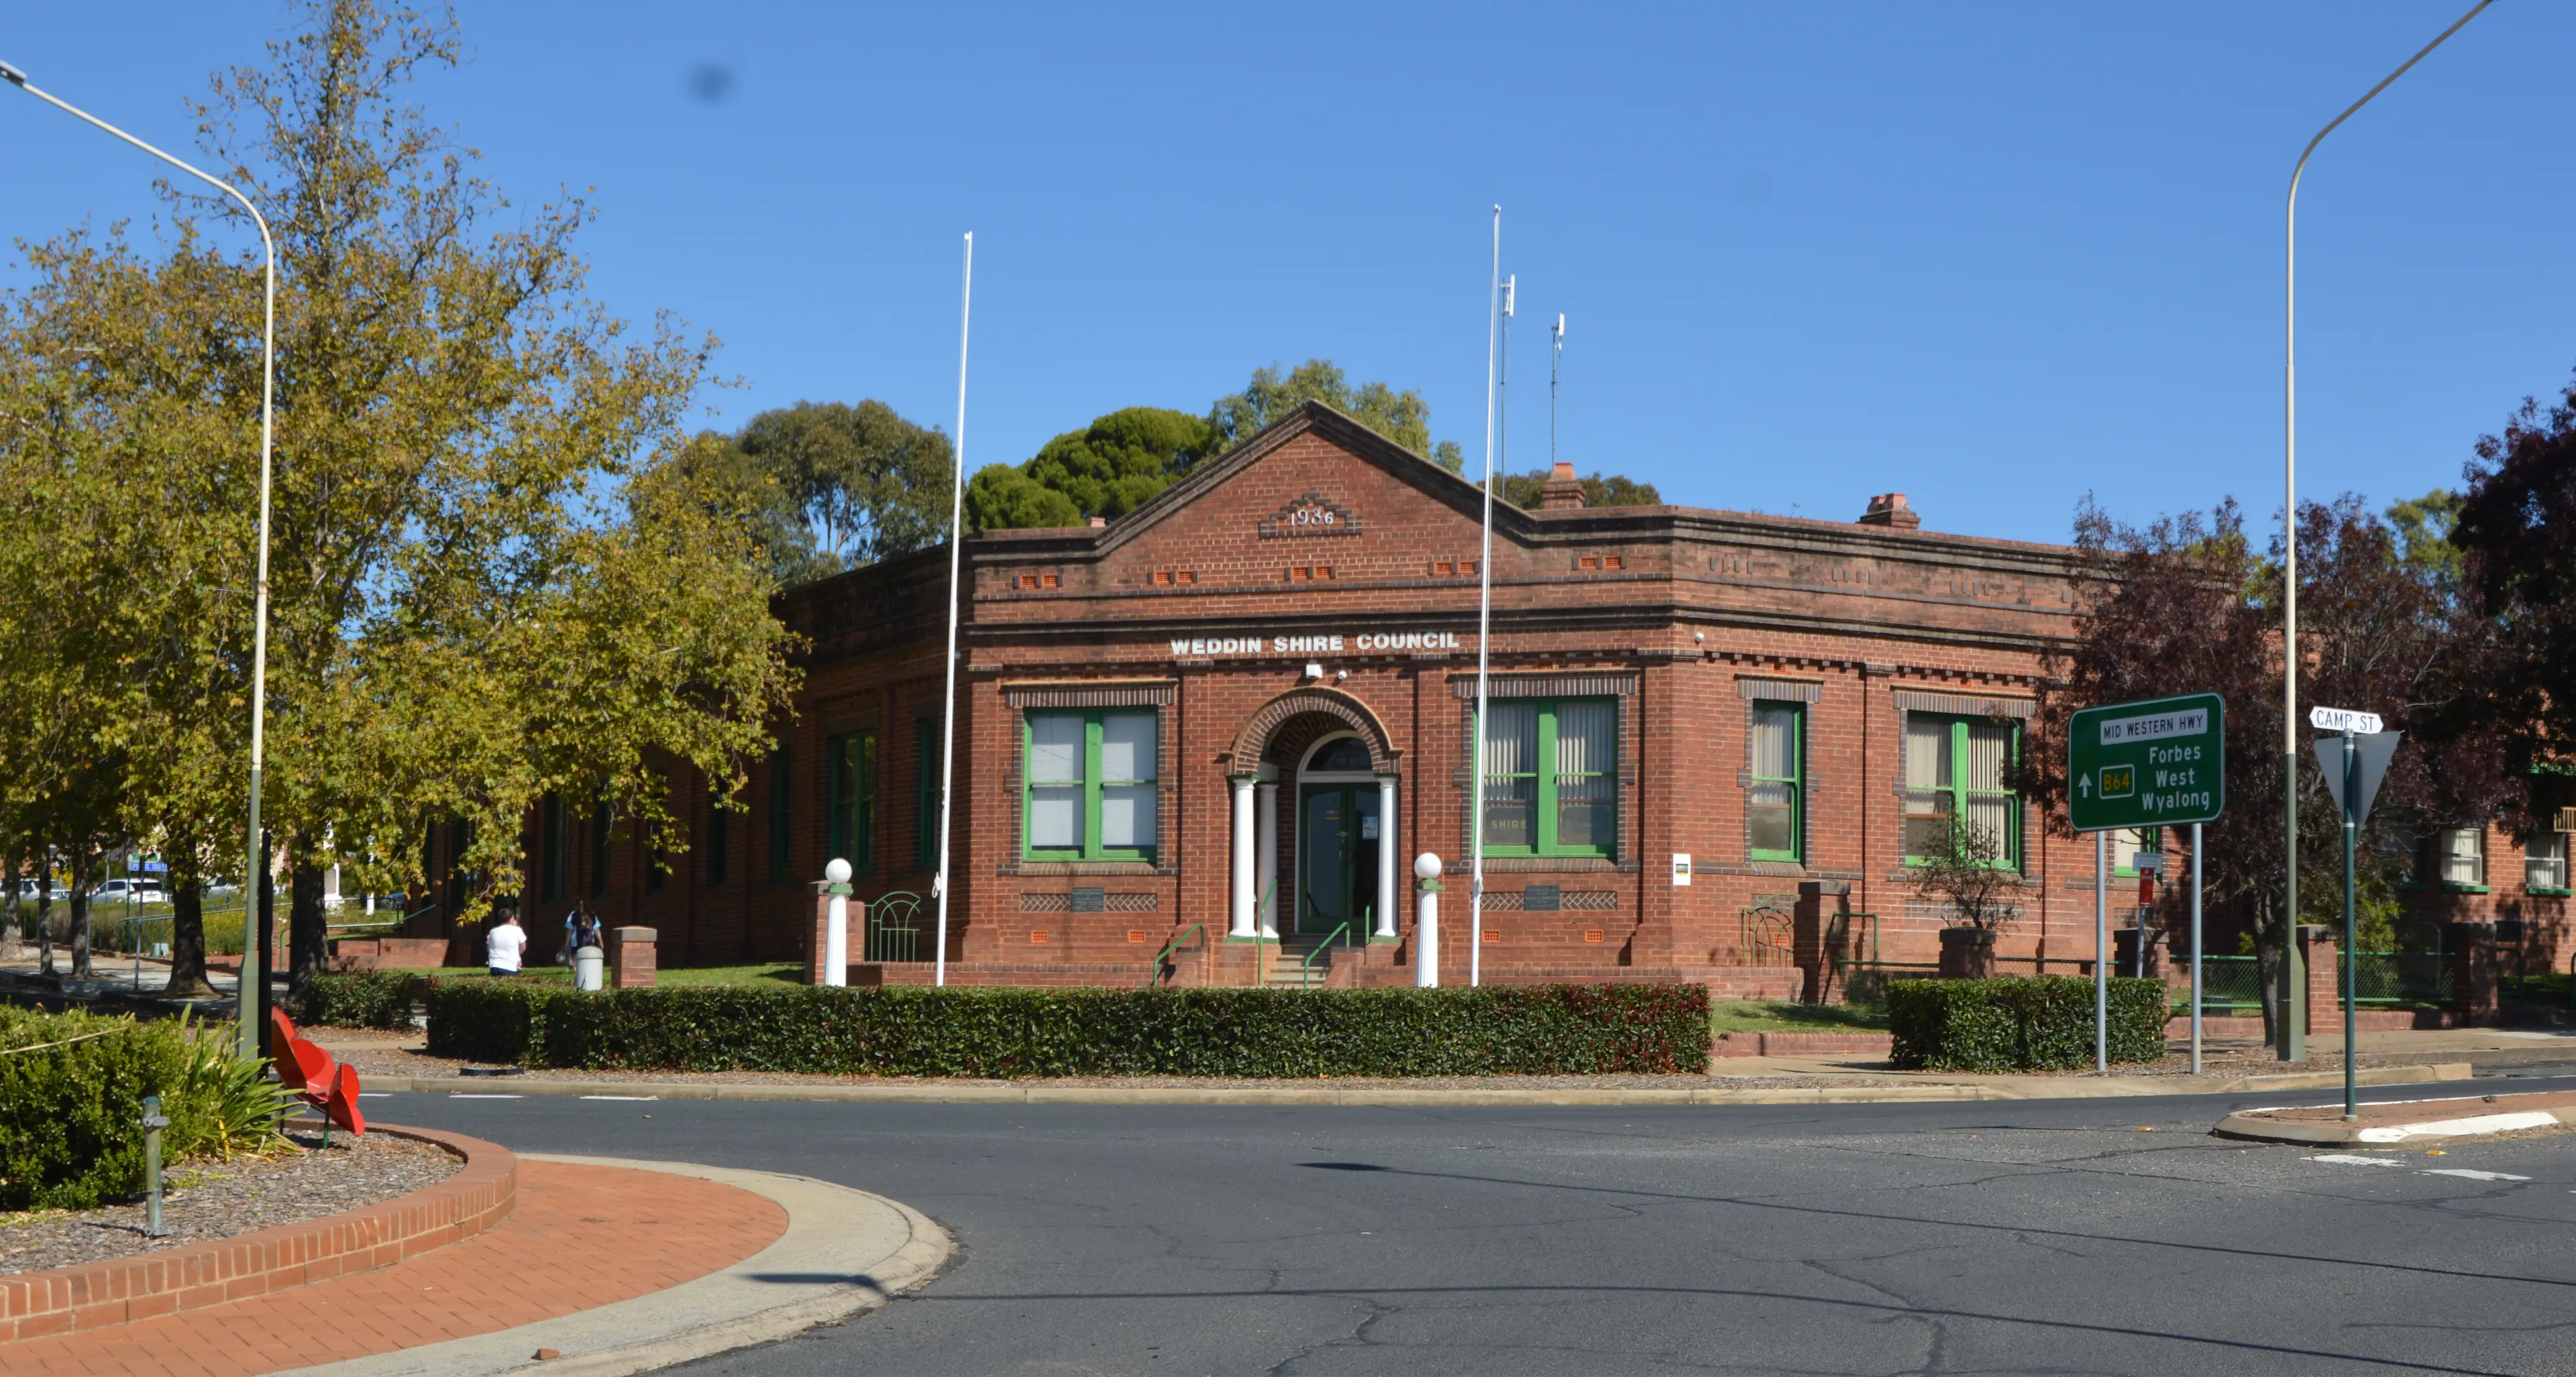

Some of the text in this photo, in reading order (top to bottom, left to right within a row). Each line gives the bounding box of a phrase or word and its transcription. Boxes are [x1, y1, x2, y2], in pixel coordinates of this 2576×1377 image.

[1291, 509, 1334, 526] 1936
[1171, 632, 1460, 655] WEDDIN SHIRE COUNCIL
[2104, 714, 2204, 739] MID WESTERN HWY
[2316, 710, 2375, 731] CAMP ST
[2149, 745, 2201, 764] Forbes
[2104, 773, 2129, 791] B64
[2156, 768, 2195, 788] West
[2142, 791, 2210, 813] Wyalong
[1491, 820, 1527, 829] SHIRE
